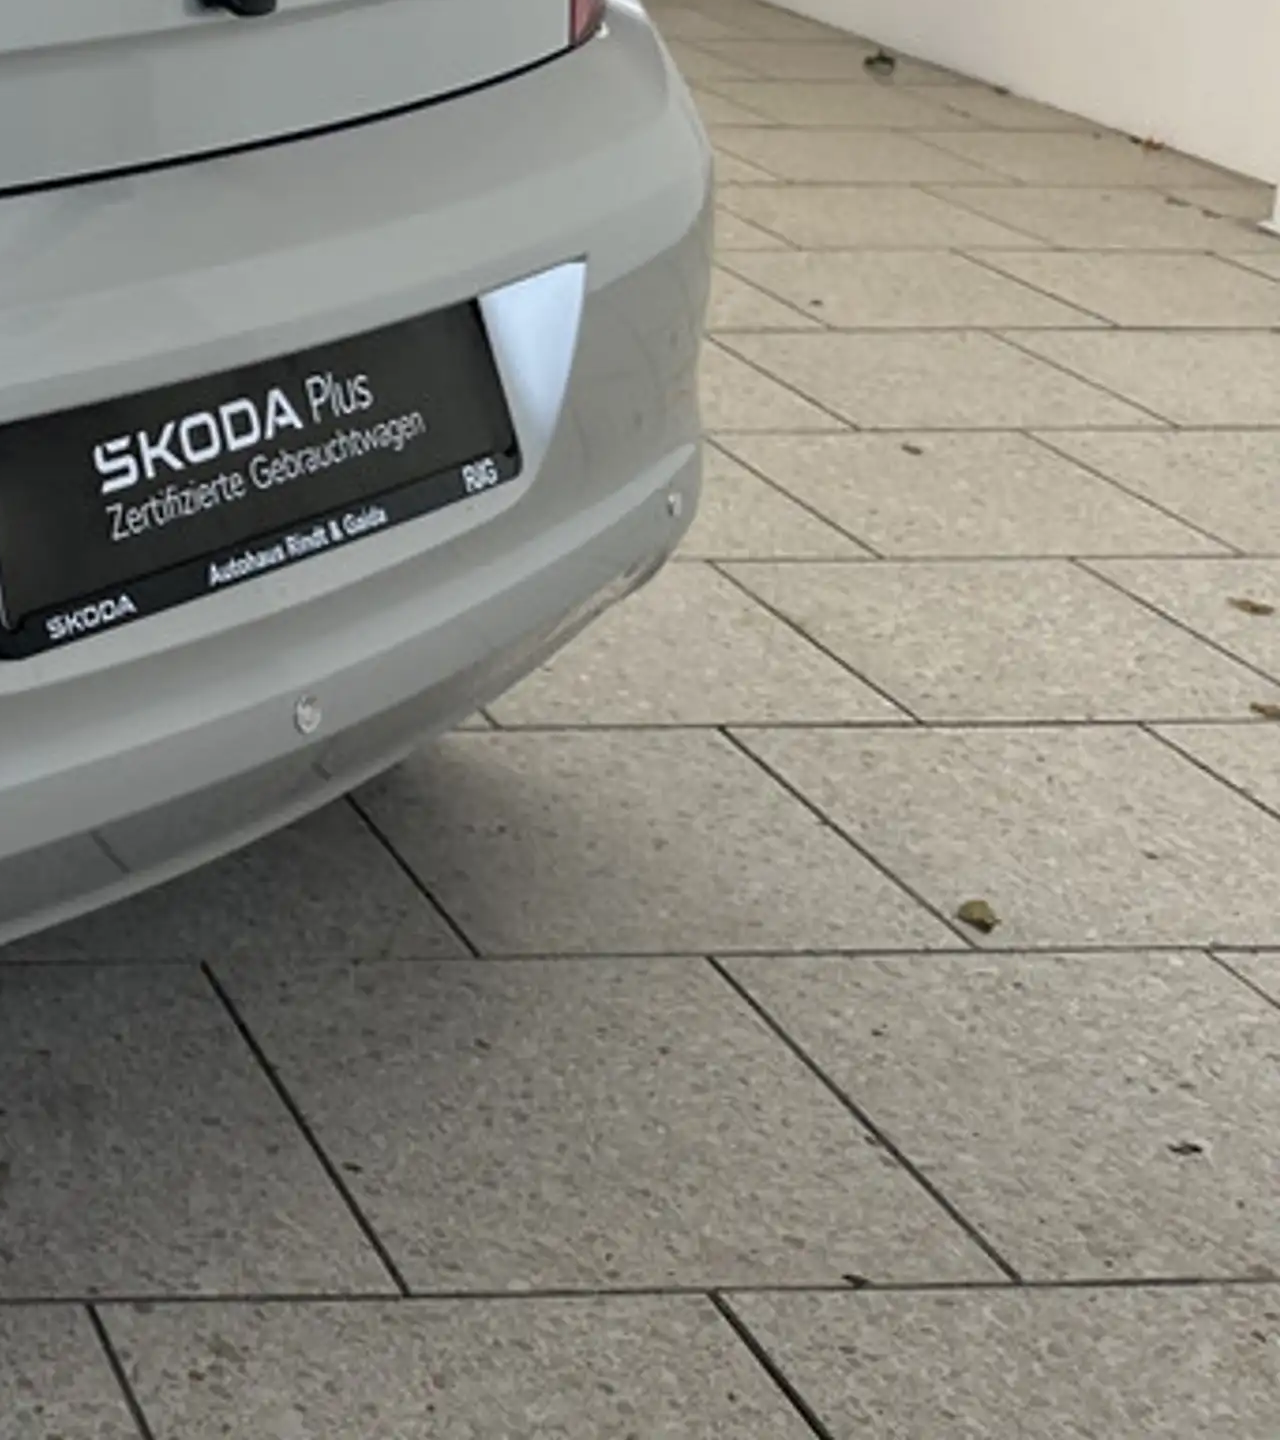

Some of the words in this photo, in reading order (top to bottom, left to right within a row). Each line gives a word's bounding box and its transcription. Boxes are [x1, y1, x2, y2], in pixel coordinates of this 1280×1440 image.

[305, 371, 374, 424] Plus
[105, 472, 246, 541] Zertifizierte
[248, 410, 426, 490] Gebrauchtwagen
[209, 545, 284, 586] Autohaus
